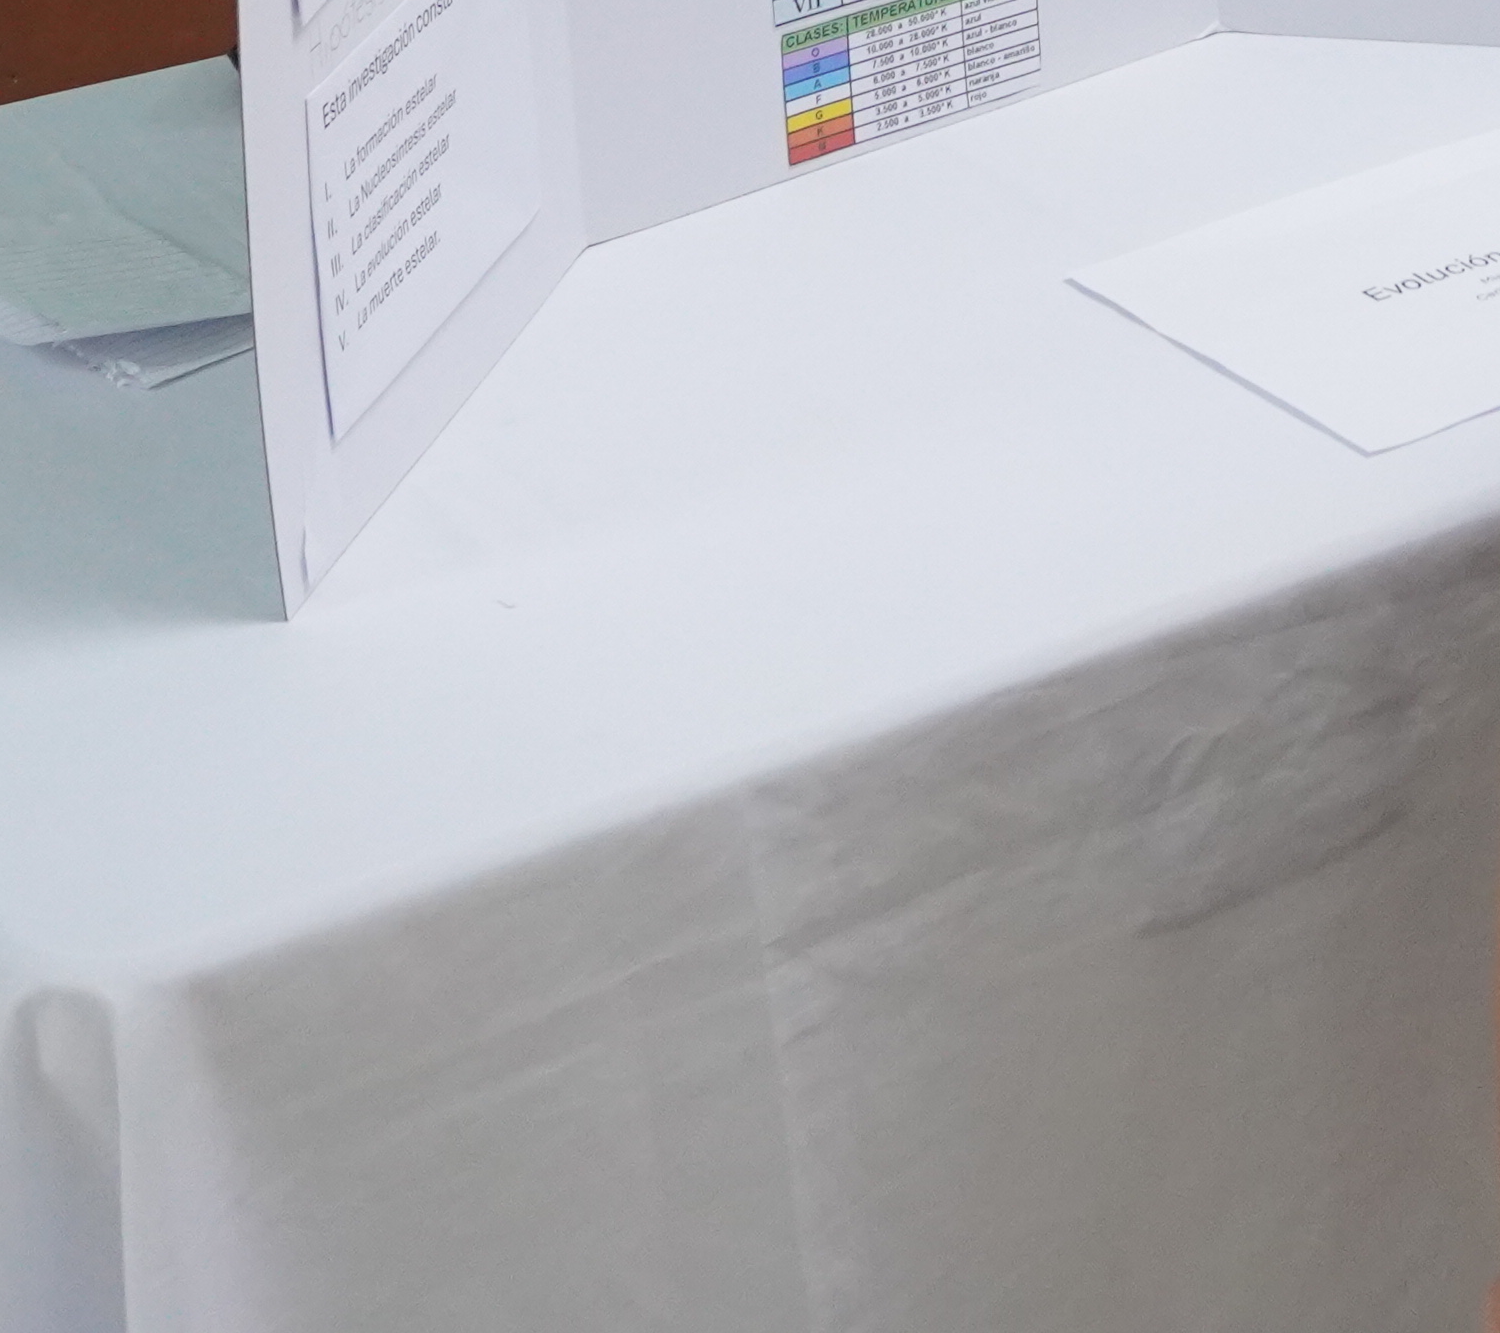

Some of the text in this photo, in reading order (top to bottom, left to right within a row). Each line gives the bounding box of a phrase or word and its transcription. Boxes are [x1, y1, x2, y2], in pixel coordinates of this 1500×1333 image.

[322, 90, 347, 130] Esta
[349, 21, 415, 102] investigación
[785, 21, 844, 48] CLASES:
[967, 42, 994, 56] blanco
[344, 158, 356, 181] La
[356, 108, 403, 166] formación
[405, 73, 437, 115] estelar
[349, 195, 360, 218] La
[361, 122, 426, 203] Nucleosintesis
[427, 89, 456, 130] estelar
[351, 233, 362, 256] La
[364, 167, 418, 240] clasificación
[419, 134, 450, 176] estelar
[355, 269, 366, 293] La
[367, 218, 410, 278] evolución
[410, 184, 442, 227] estelar
[358, 307, 368, 330] La
[369, 267, 404, 315] muerte
[405, 231, 441, 275] estelar.
